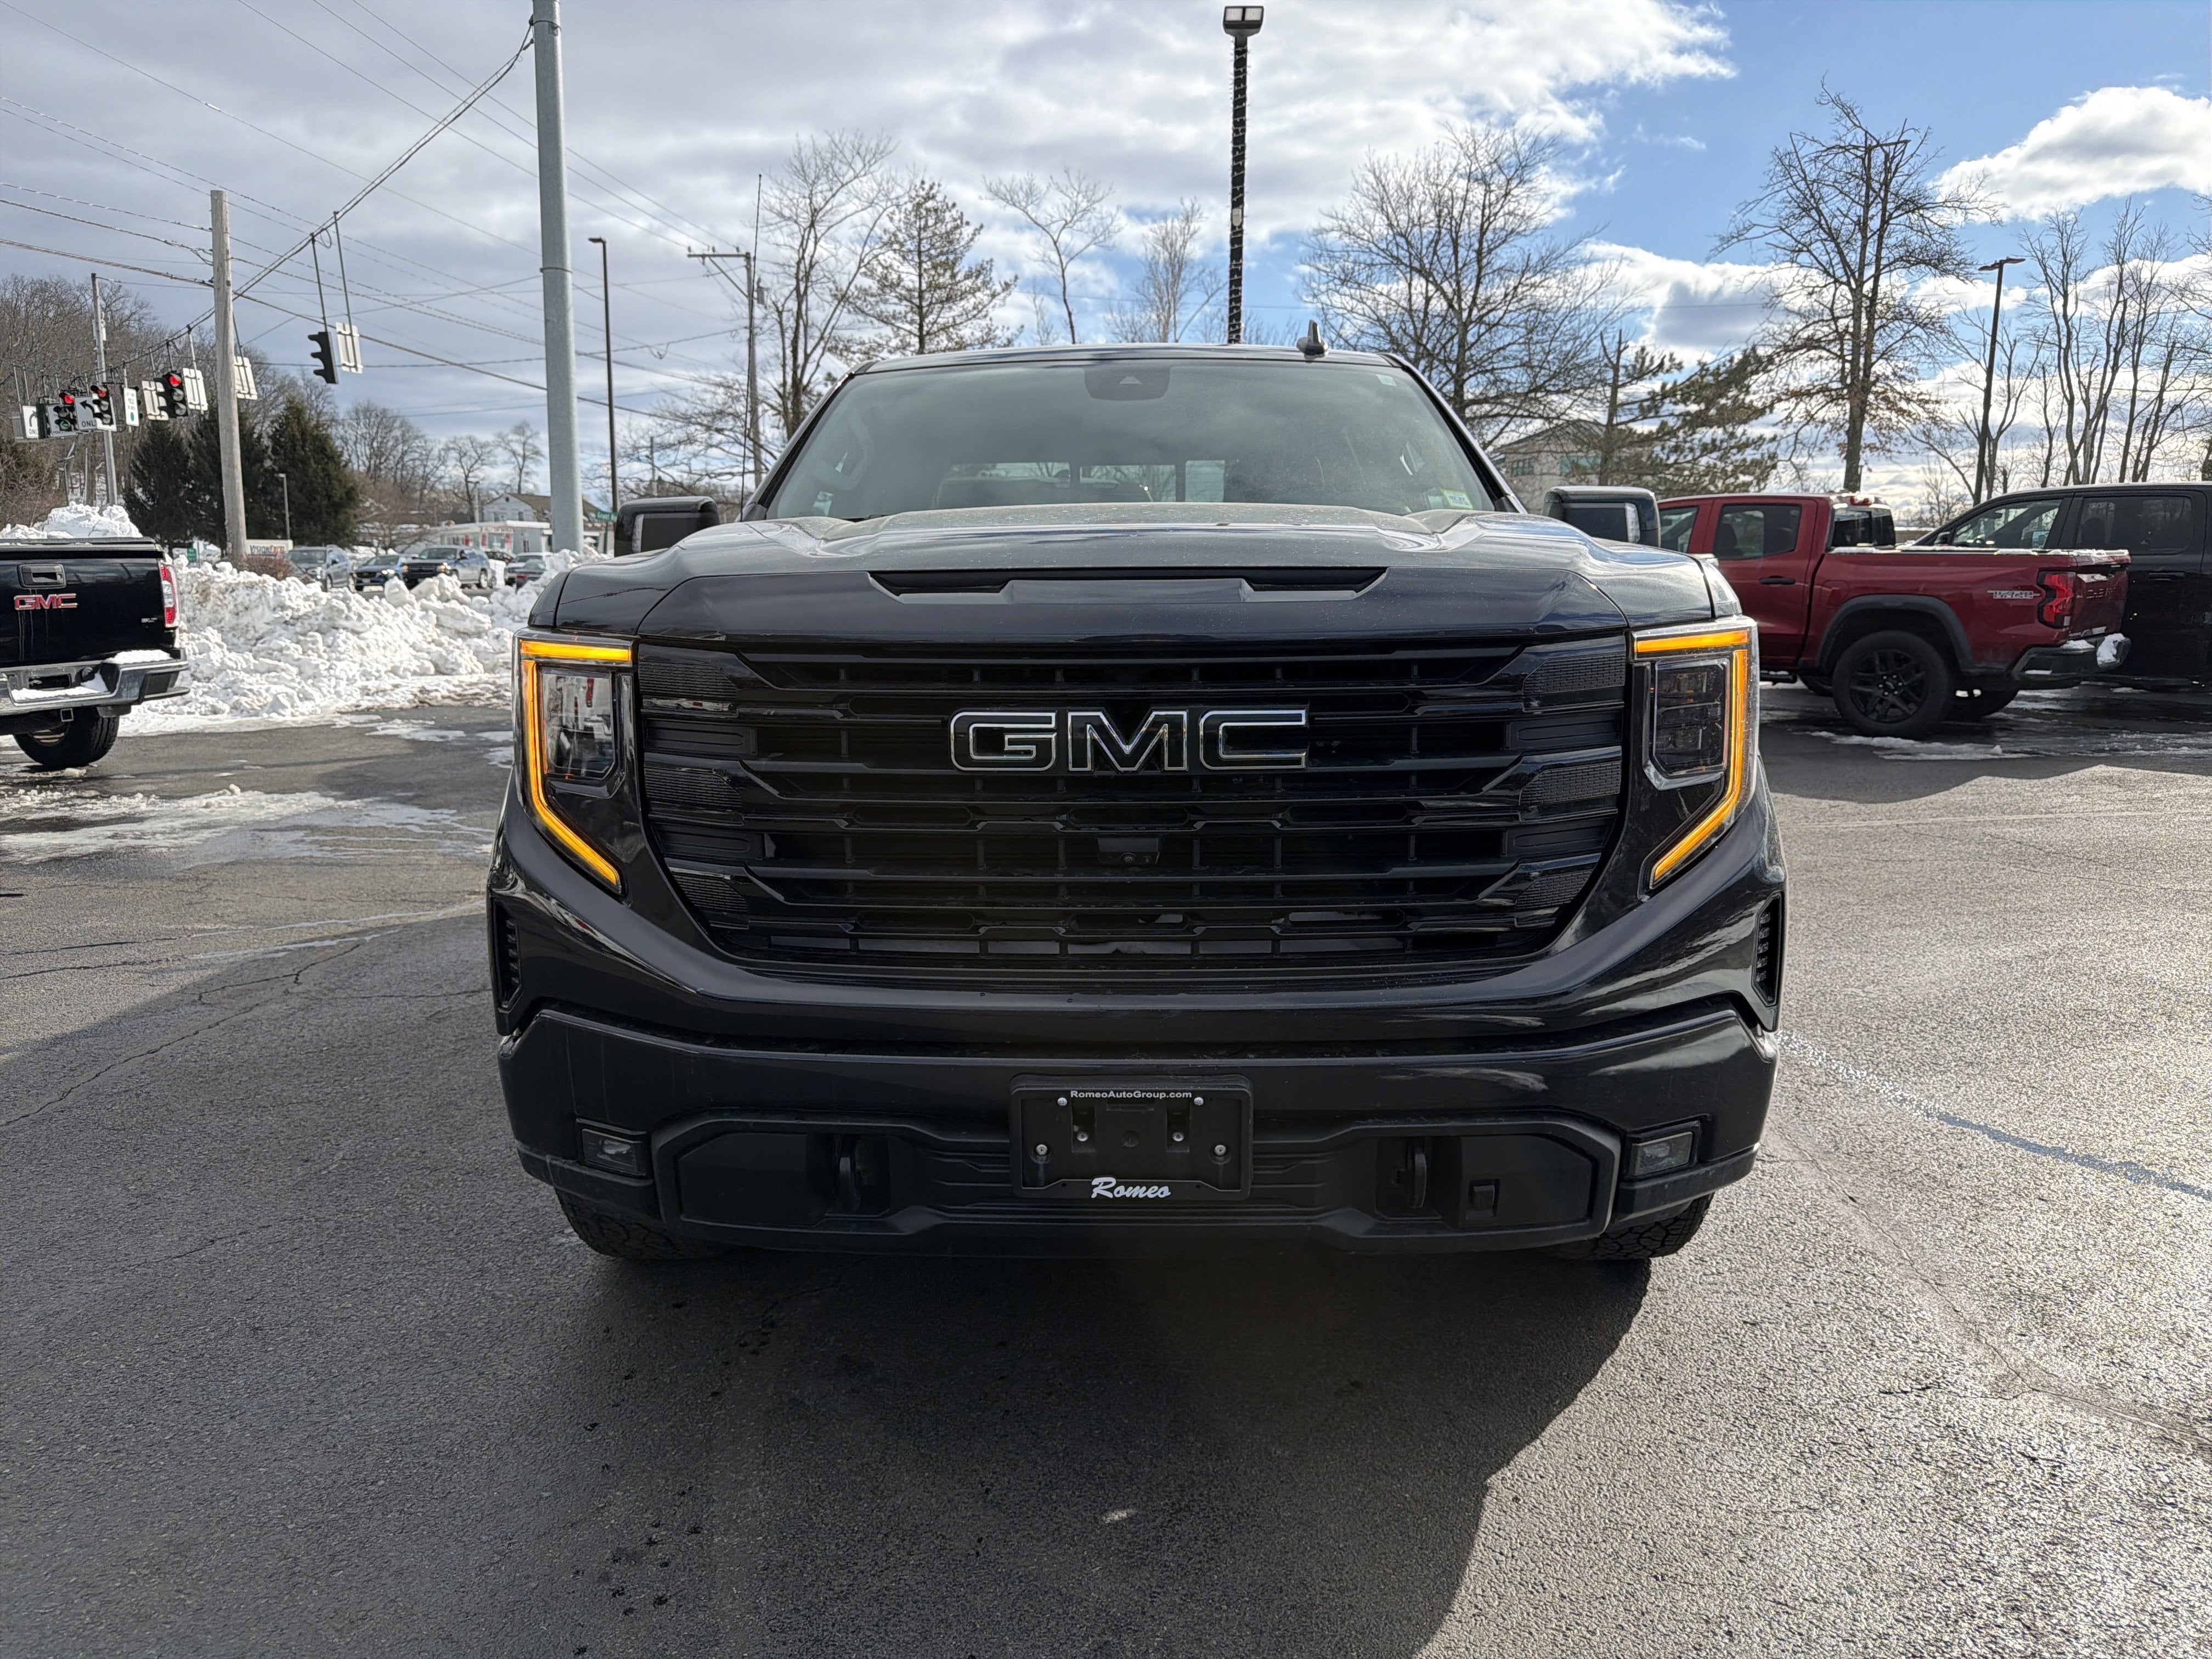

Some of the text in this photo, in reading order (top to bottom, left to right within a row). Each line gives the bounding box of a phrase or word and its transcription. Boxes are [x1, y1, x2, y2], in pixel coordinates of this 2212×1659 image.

[14, 593, 78, 611] GMC
[950, 709, 1308, 772] GMC
[1070, 1091, 1192, 1099] RomeoAutoGroup.com
[1091, 1177, 1171, 1199] Romeo
